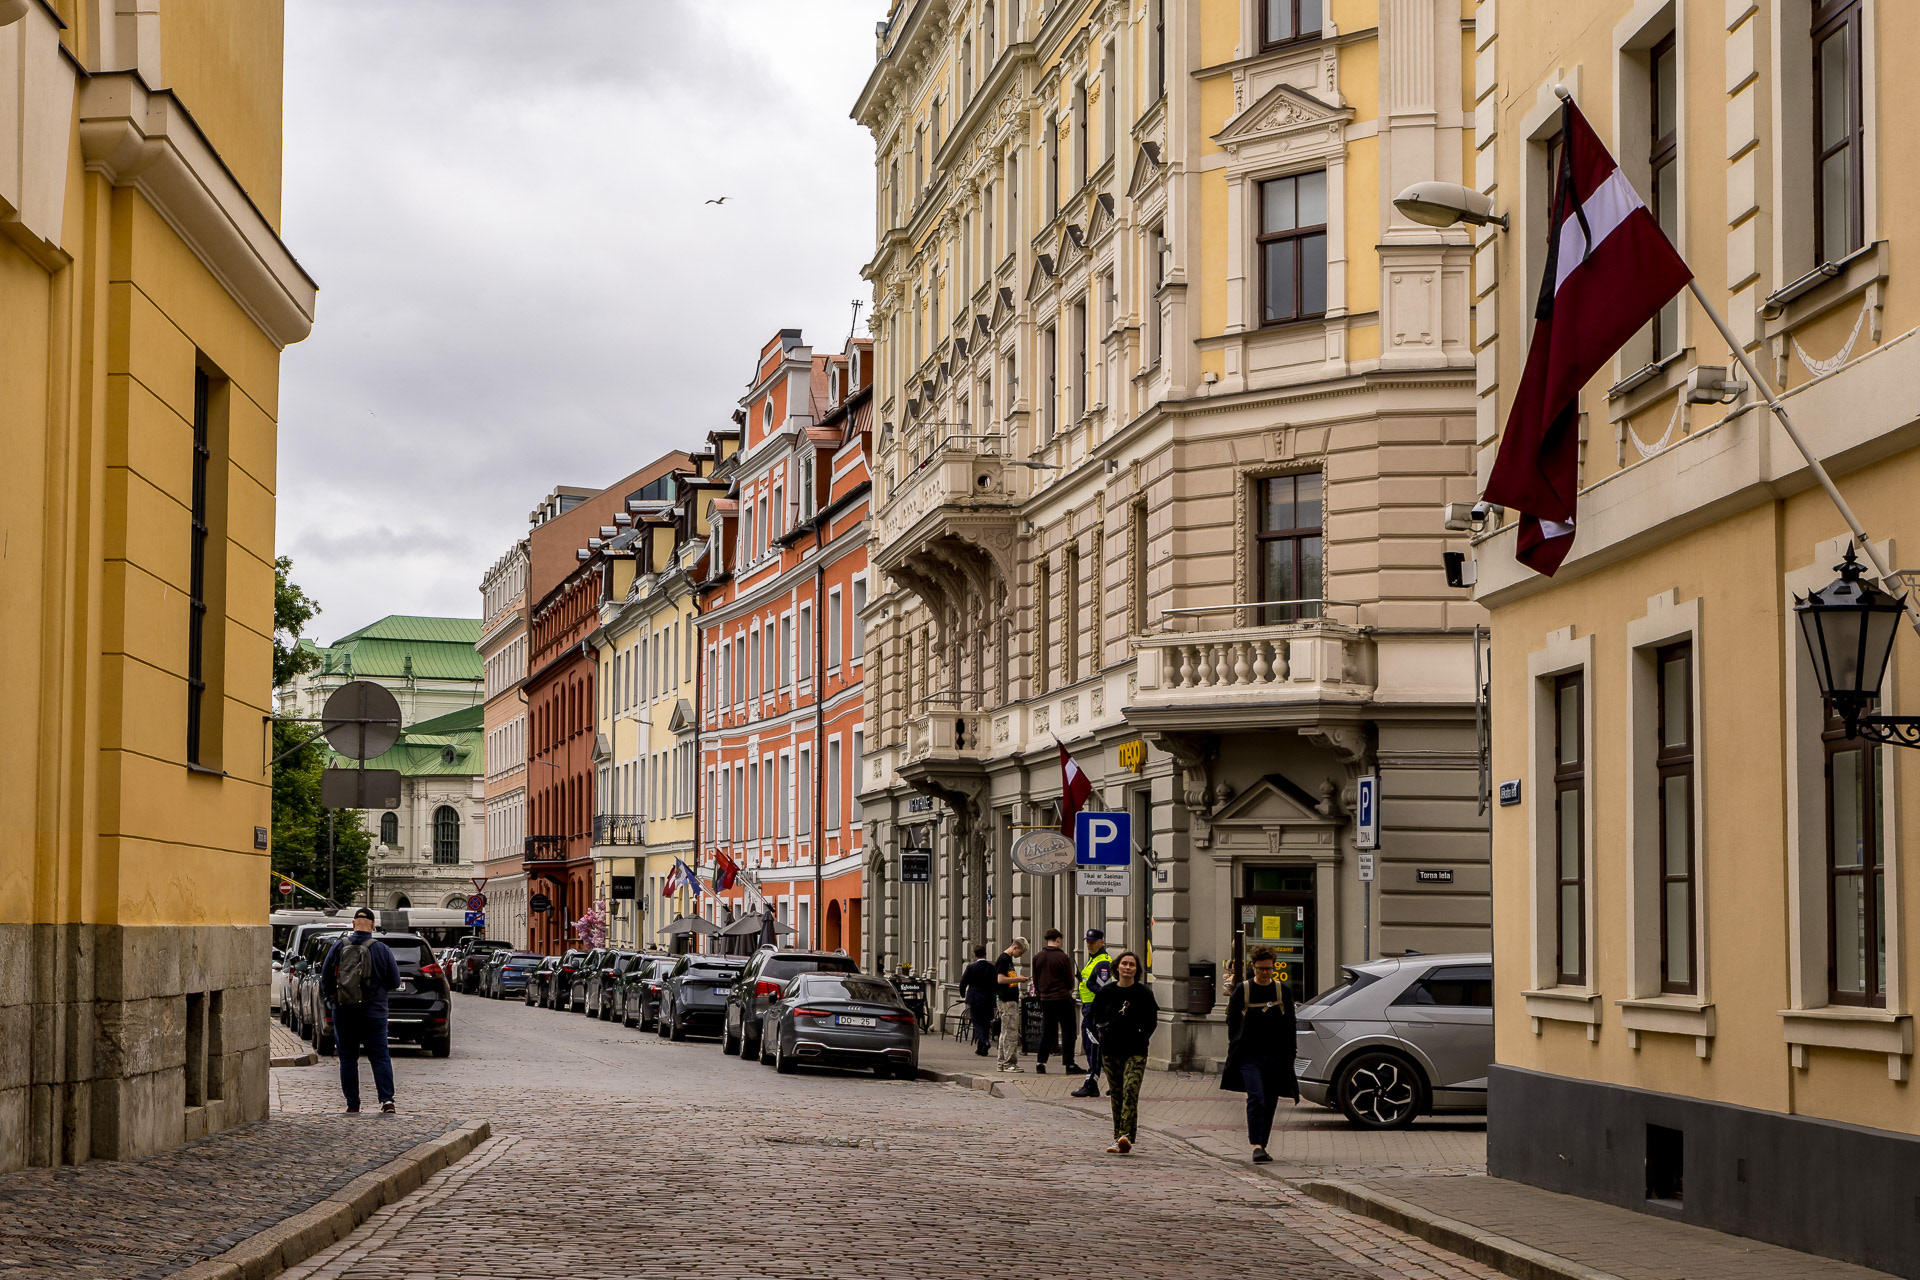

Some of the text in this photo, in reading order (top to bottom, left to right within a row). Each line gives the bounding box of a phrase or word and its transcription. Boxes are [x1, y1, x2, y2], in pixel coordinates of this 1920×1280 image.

[1119, 740, 1146, 773] mego
[1362, 786, 1369, 821] P
[1088, 818, 1118, 859] P
[1360, 831, 1371, 843] ZONA
